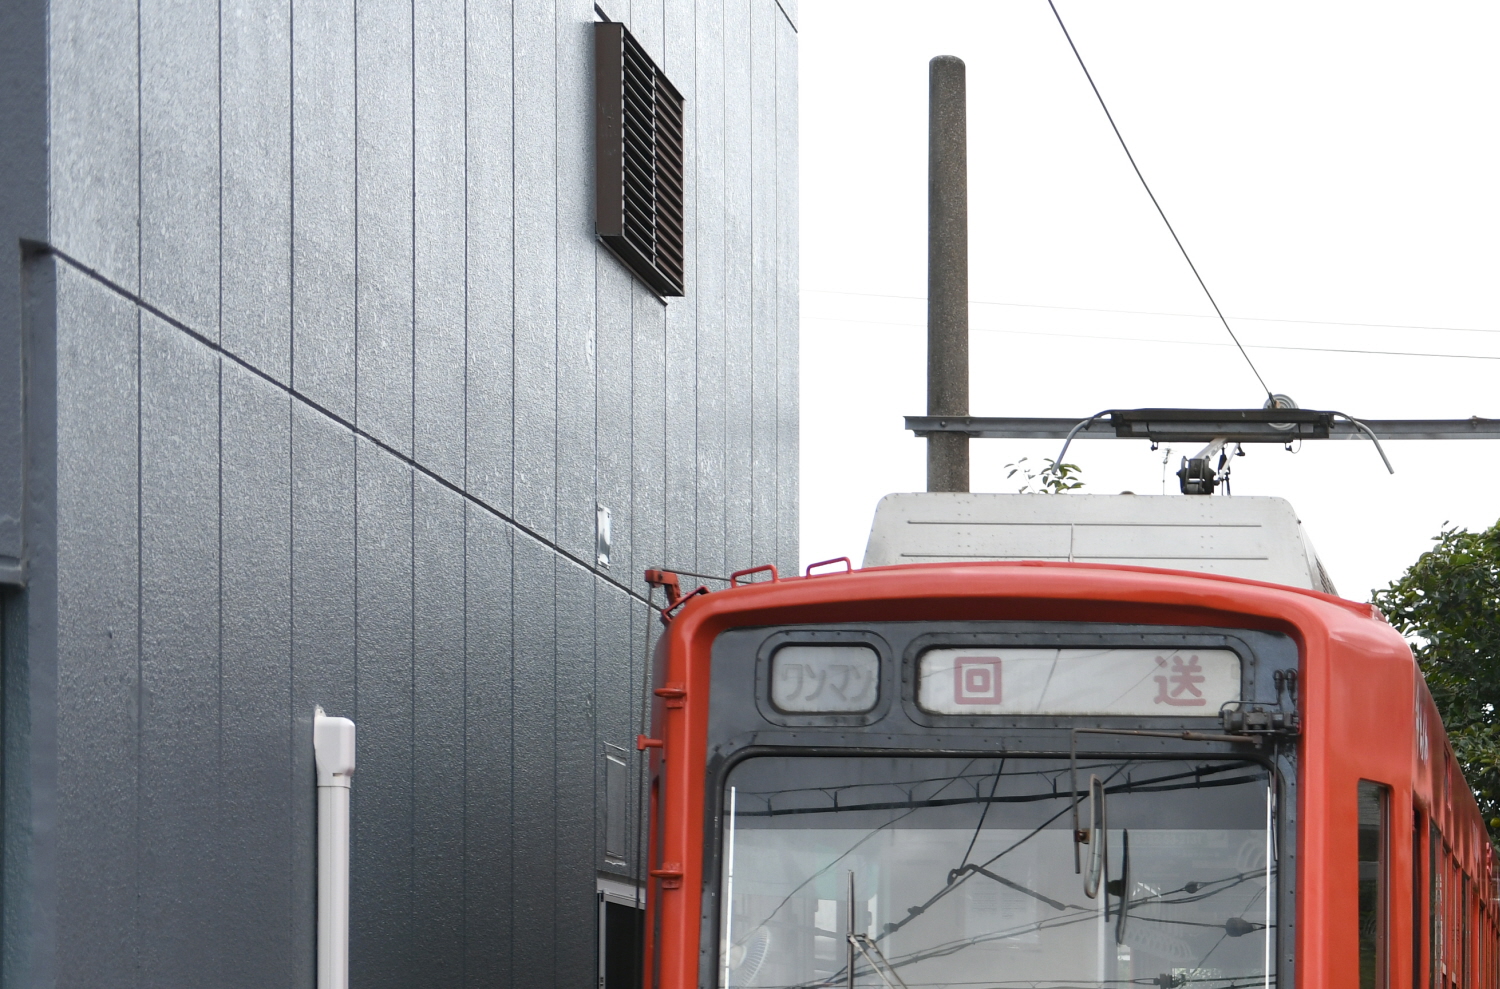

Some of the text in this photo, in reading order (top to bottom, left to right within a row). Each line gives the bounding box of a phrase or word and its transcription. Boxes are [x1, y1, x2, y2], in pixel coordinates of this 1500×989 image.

[781, 663, 873, 702] ワンマン
[953, 655, 1206, 707] 回 送
